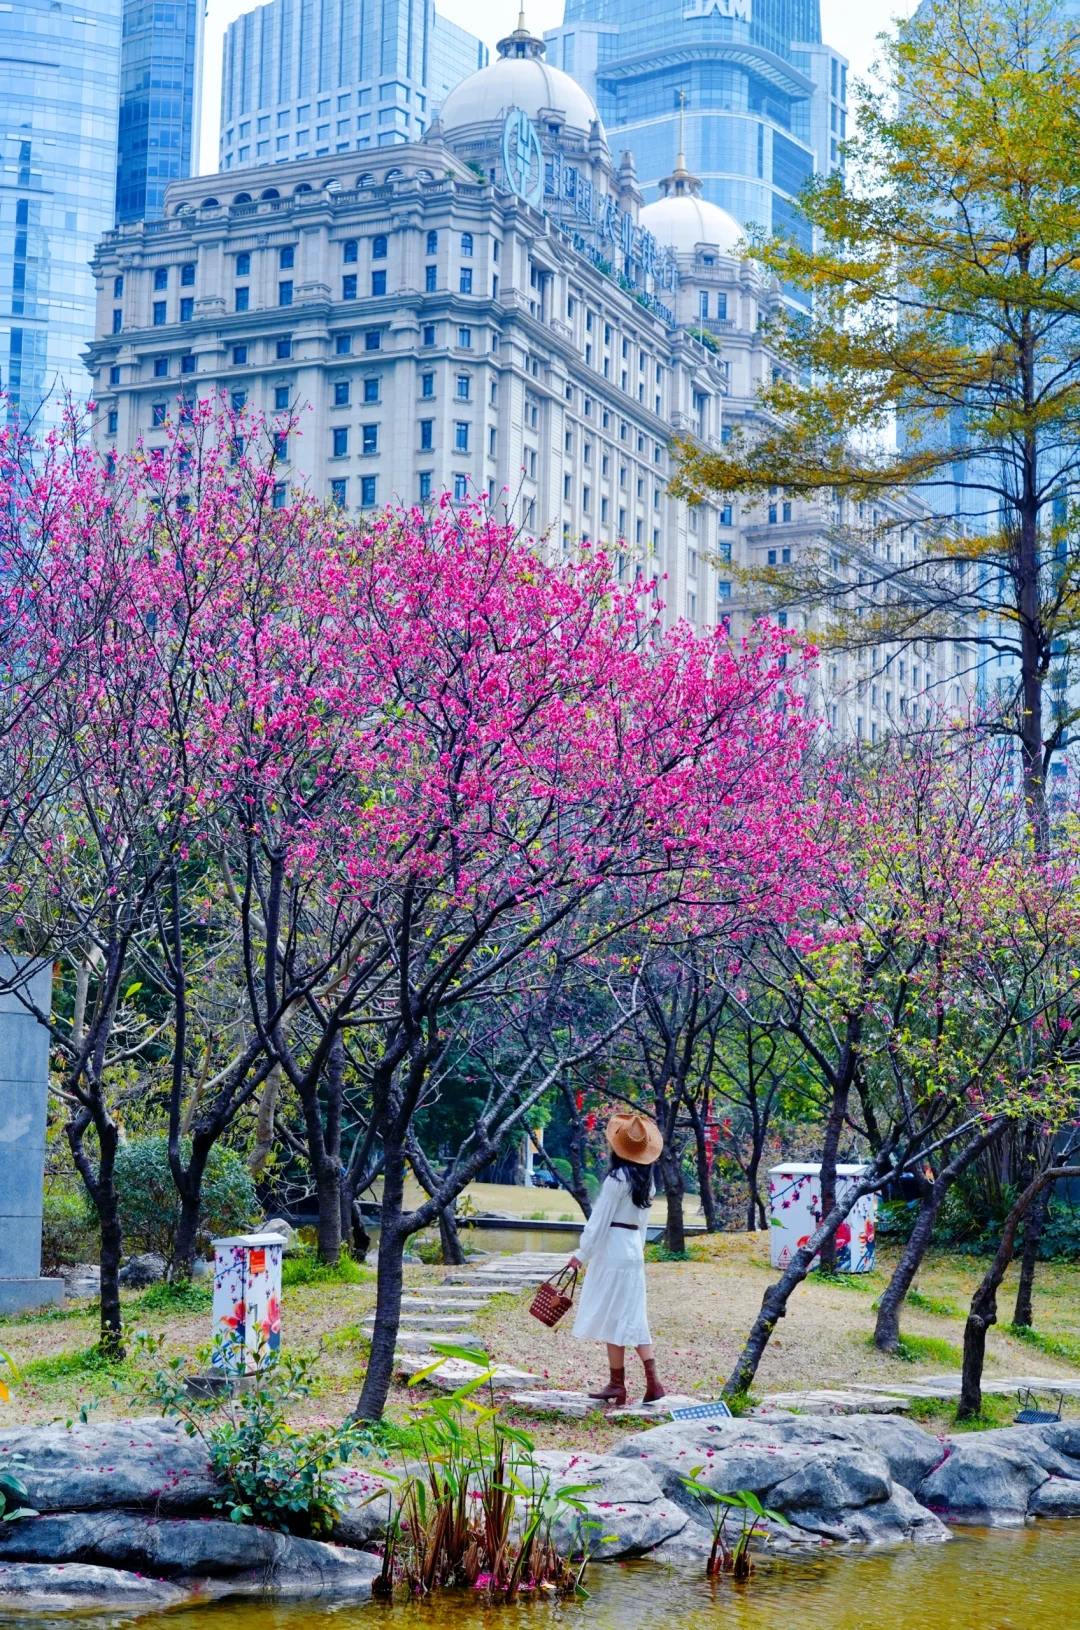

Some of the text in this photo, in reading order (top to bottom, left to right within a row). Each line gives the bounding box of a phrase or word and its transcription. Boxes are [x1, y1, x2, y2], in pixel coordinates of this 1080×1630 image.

[552, 150, 679, 293] 中国农业银行
